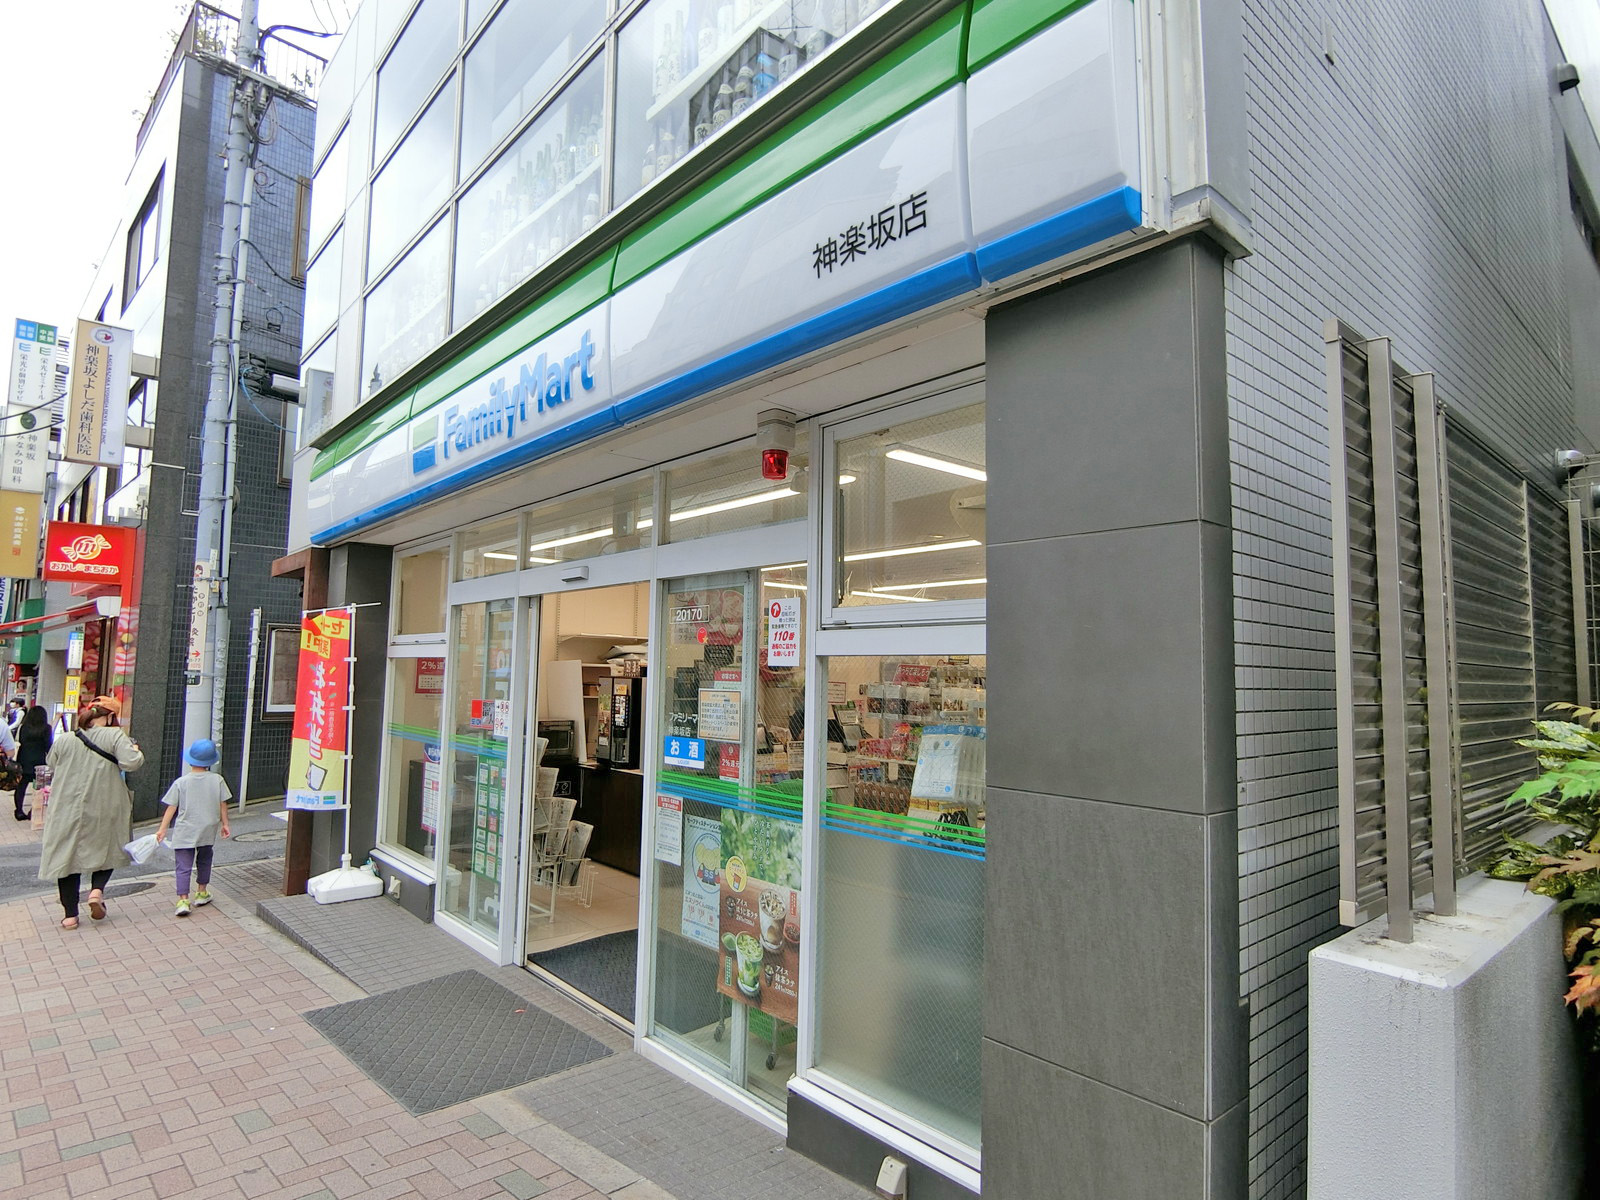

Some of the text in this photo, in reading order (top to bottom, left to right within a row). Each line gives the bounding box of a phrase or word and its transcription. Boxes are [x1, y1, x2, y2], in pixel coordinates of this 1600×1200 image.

[813, 191, 927, 279] 神楽坂店
[76, 343, 100, 456] 神楽坂よしだ歯科医院
[444, 328, 596, 459] FamilyMart
[26, 433, 38, 461] 神楽坂
[676, 608, 702, 622] 20170
[773, 631, 796, 641] 110番
[669, 712, 699, 724] ファミリーマ
[670, 739, 699, 759] お酒
